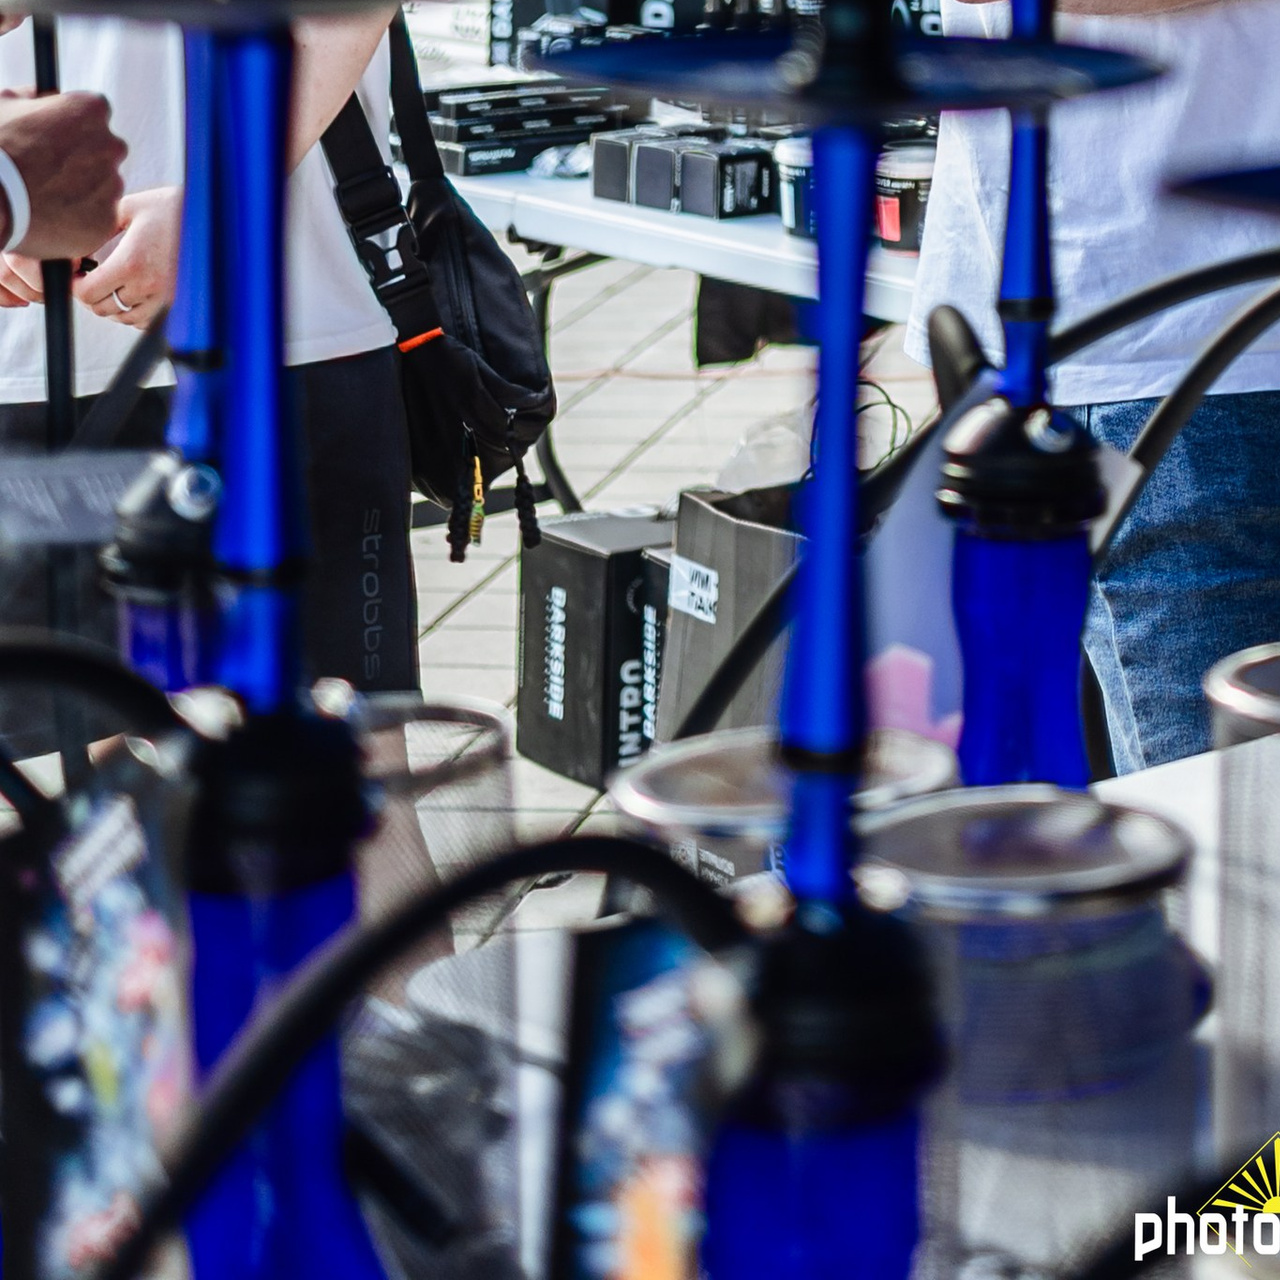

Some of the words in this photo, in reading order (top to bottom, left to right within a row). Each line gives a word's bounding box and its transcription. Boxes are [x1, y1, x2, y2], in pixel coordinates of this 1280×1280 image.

[362, 508, 383, 681] strobbs
[548, 586, 567, 721] DARKSIDE
[643, 603, 657, 740] DARKSIDE
